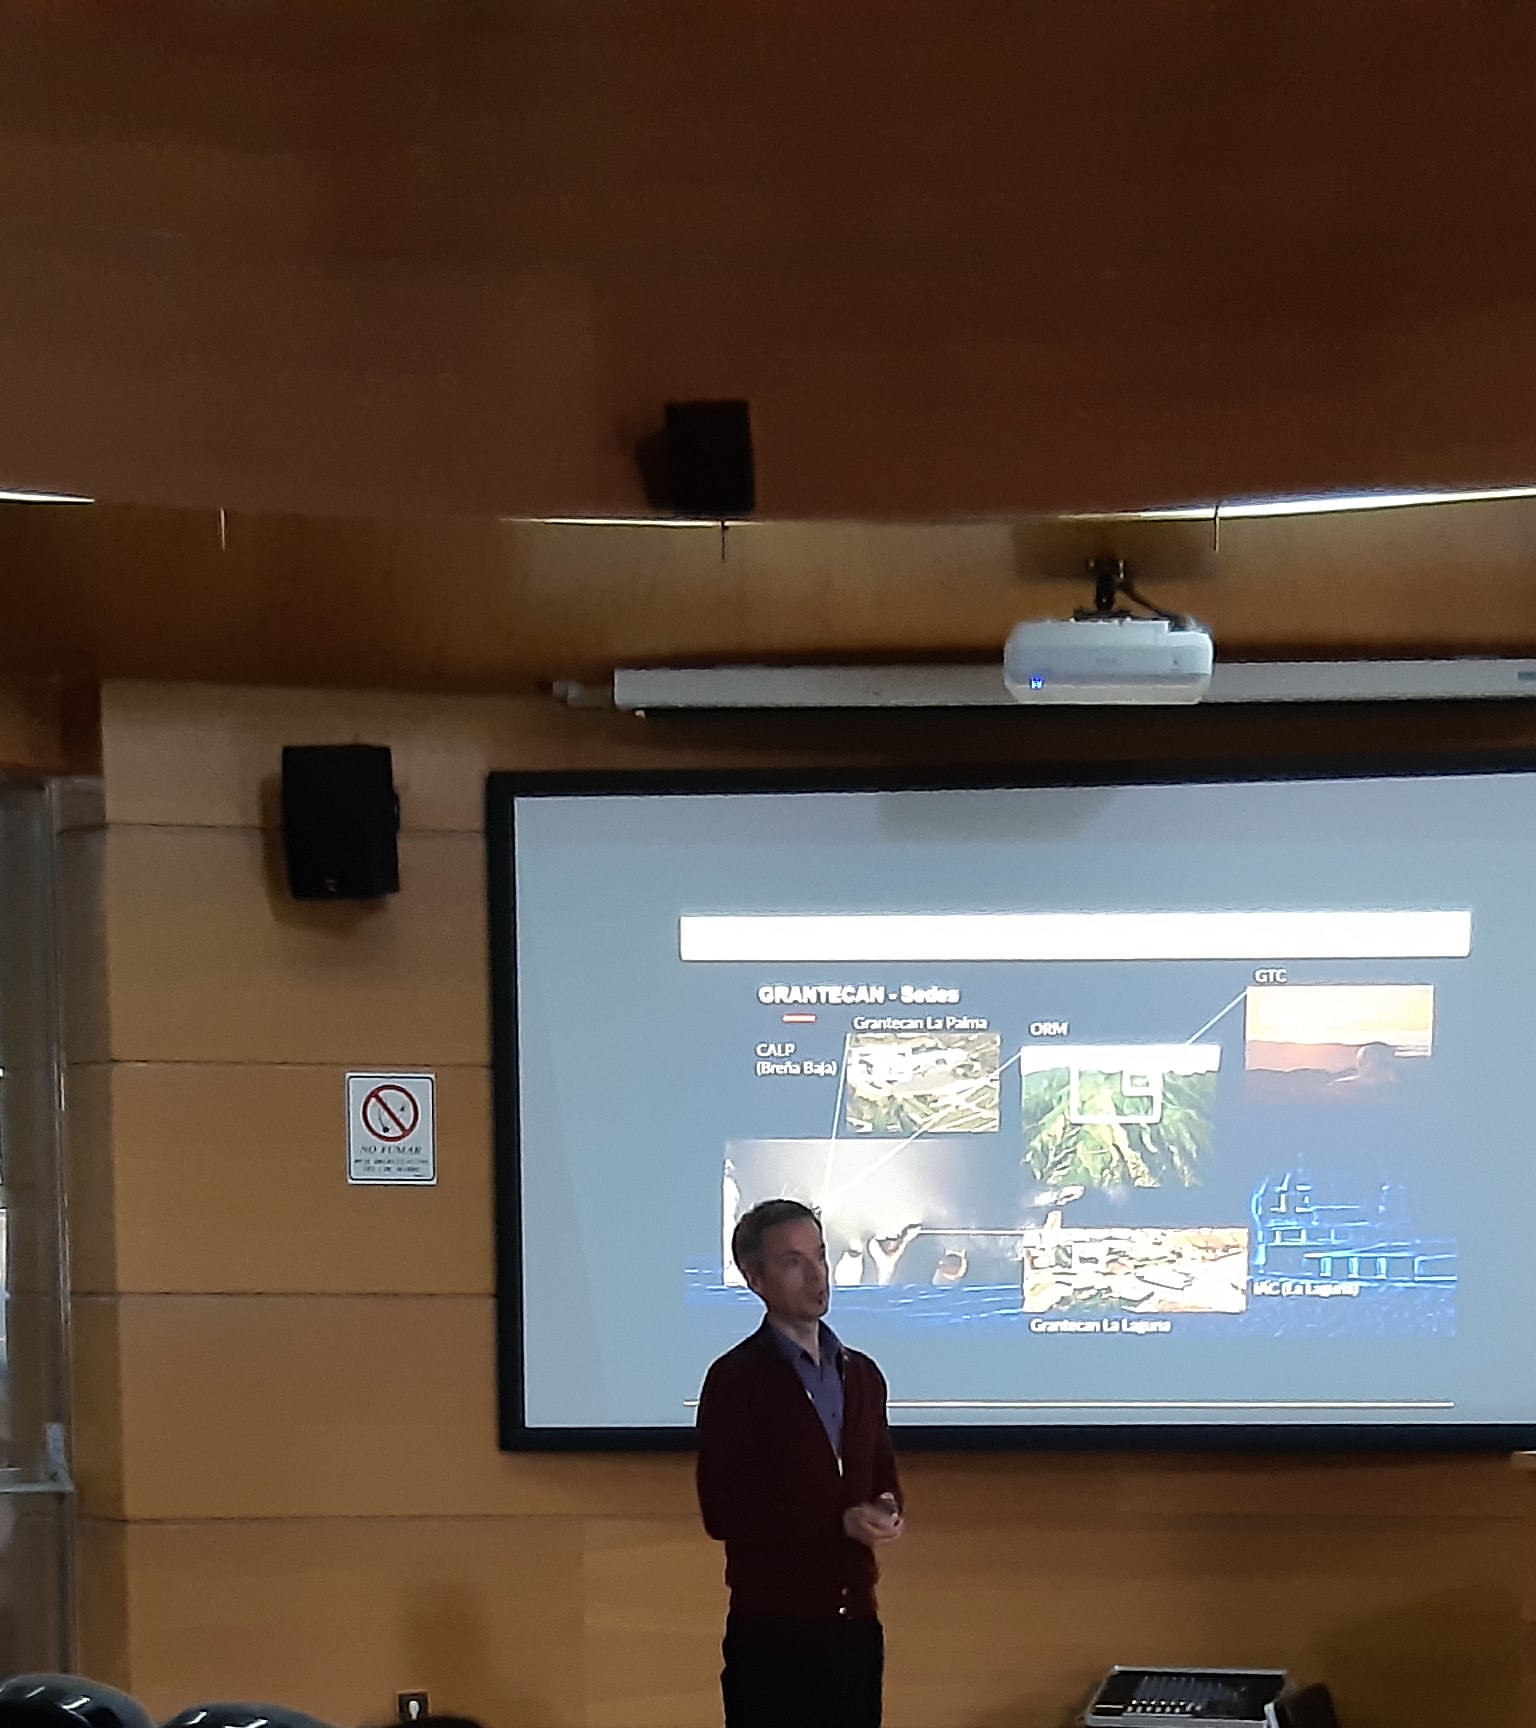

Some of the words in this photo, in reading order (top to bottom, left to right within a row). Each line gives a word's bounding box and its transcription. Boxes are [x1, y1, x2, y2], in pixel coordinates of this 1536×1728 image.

[1254, 968, 1288, 983] GTC
[758, 985, 885, 1004] GRANTECAN
[900, 984, 960, 1004] Sedes
[852, 1015, 924, 1031] Grantecan
[926, 1015, 944, 1030] La
[946, 1015, 988, 1031] Palma
[1029, 1022, 1069, 1036] ORM
[755, 1043, 796, 1057] CALP
[755, 1060, 801, 1077] (Breña
[803, 1060, 838, 1077] Baja)
[1030, 1318, 1101, 1333] Grantecan
[1102, 1318, 1120, 1333] La
[1121, 1318, 1172, 1335] Laguna
